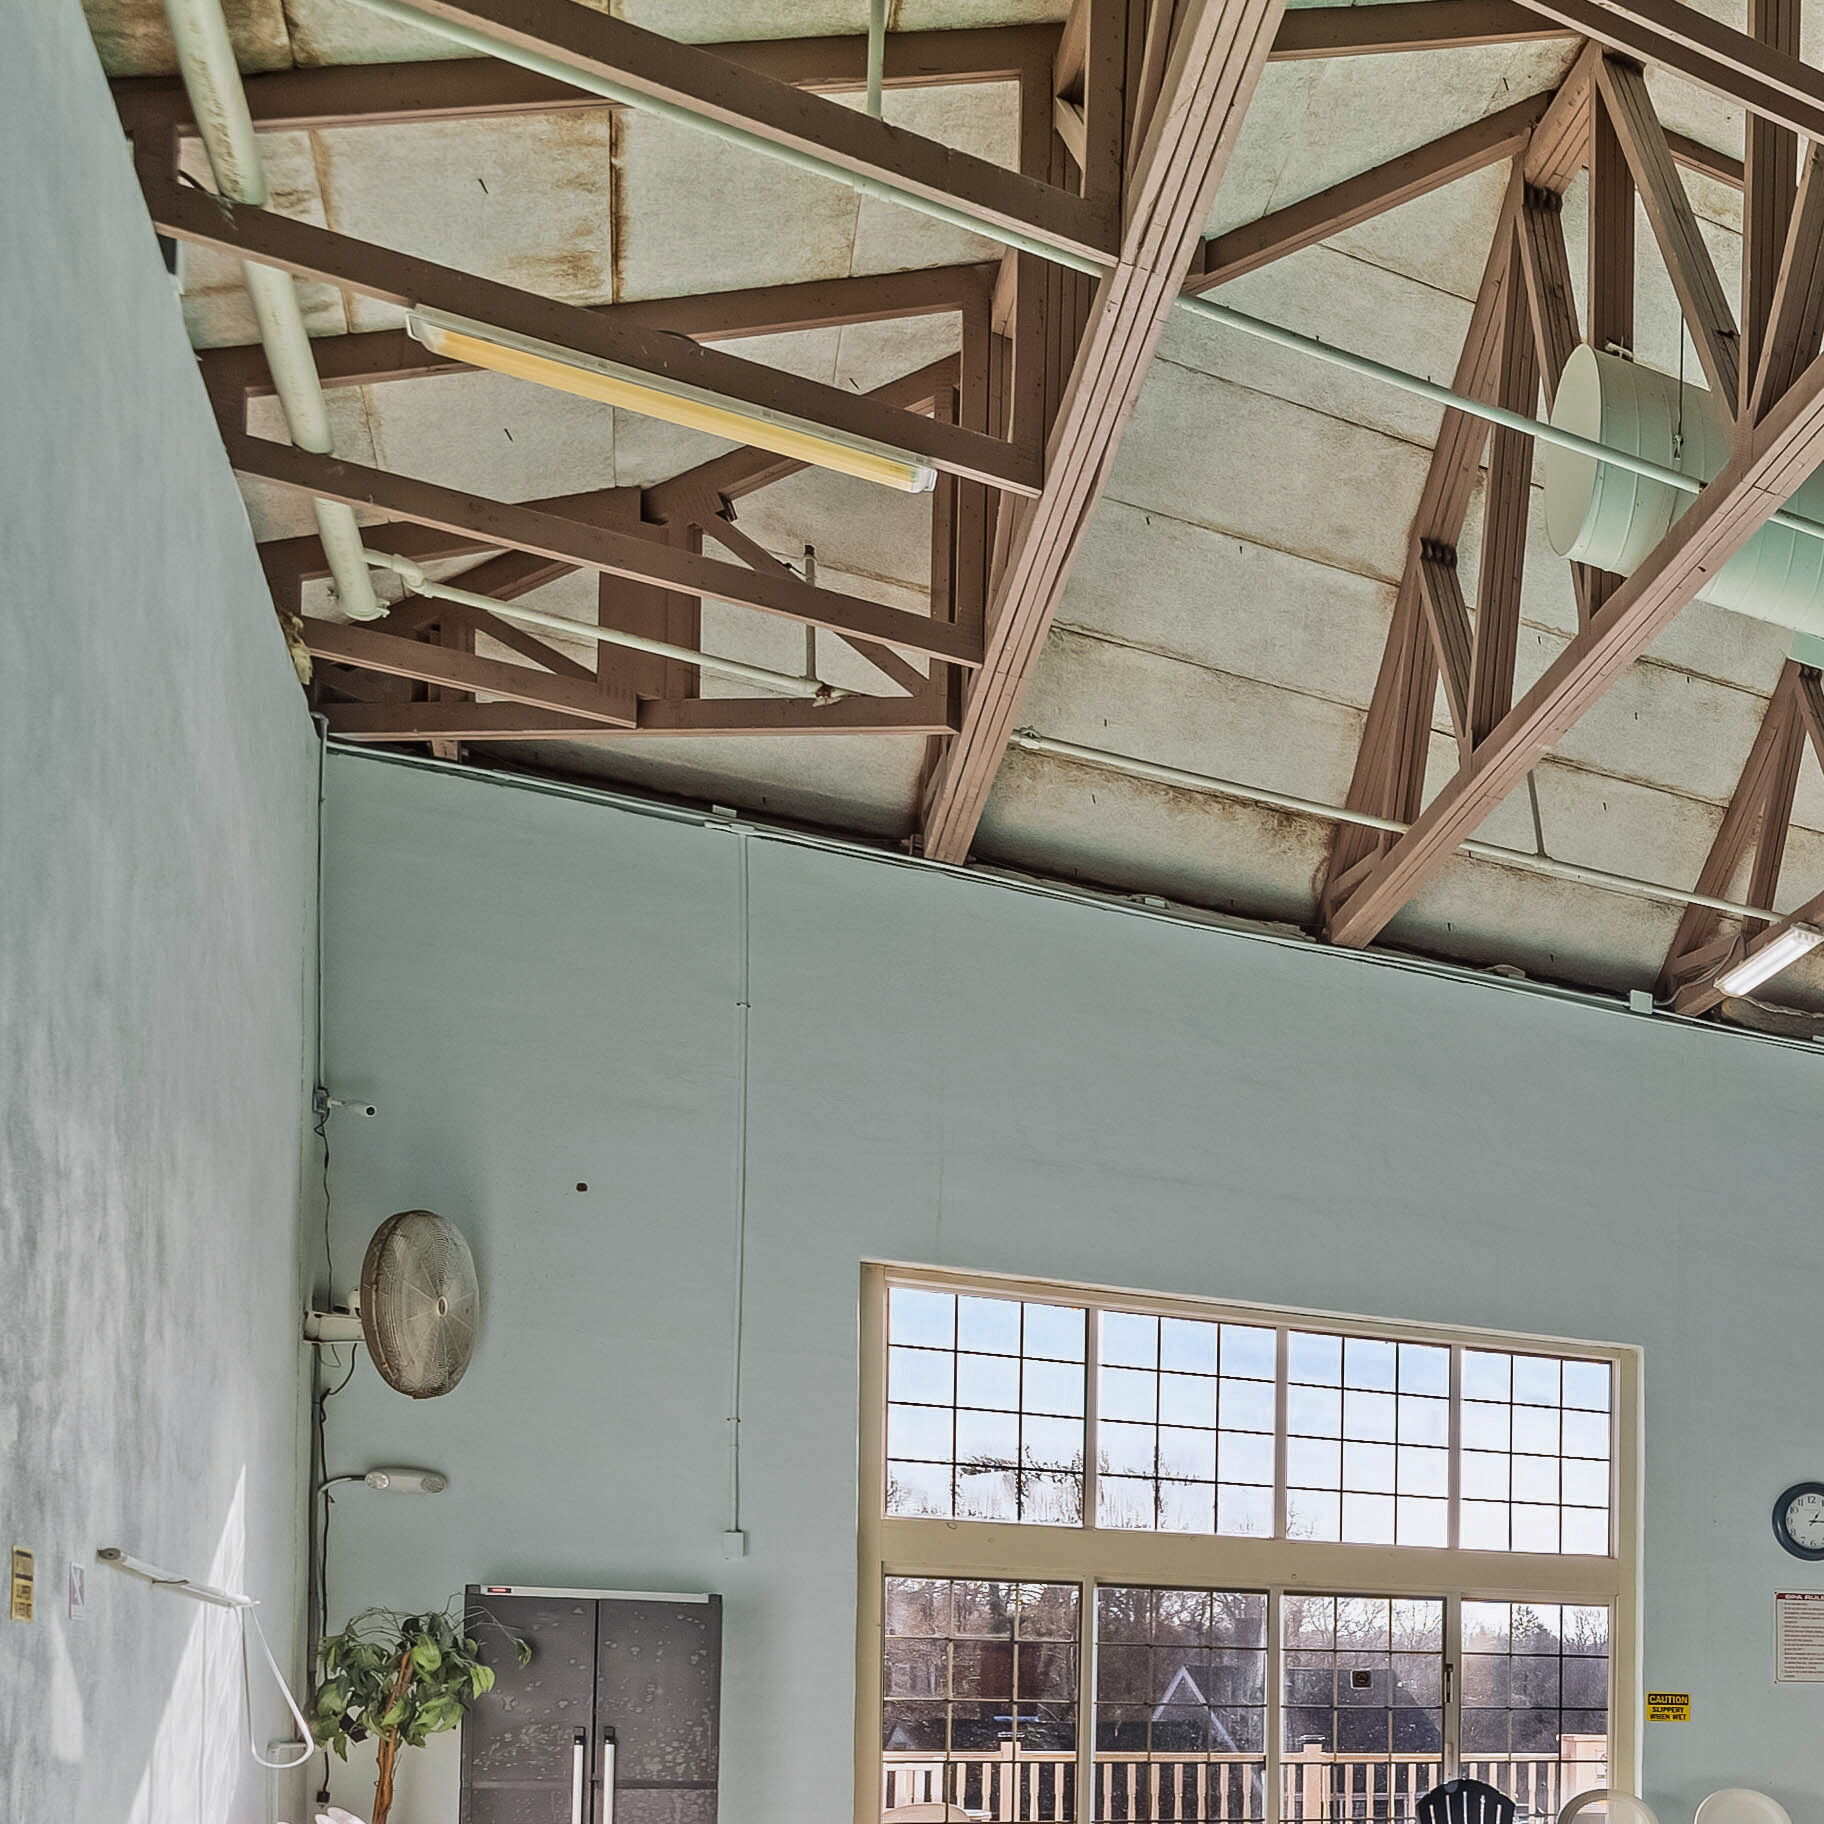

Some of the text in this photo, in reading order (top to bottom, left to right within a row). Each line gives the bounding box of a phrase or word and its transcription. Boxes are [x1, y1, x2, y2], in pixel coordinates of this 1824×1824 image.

[1798, 1498, 1804, 1506] 11
[1808, 1496, 1816, 1504] 12
[1649, 1695, 1688, 1704] CAUTION
